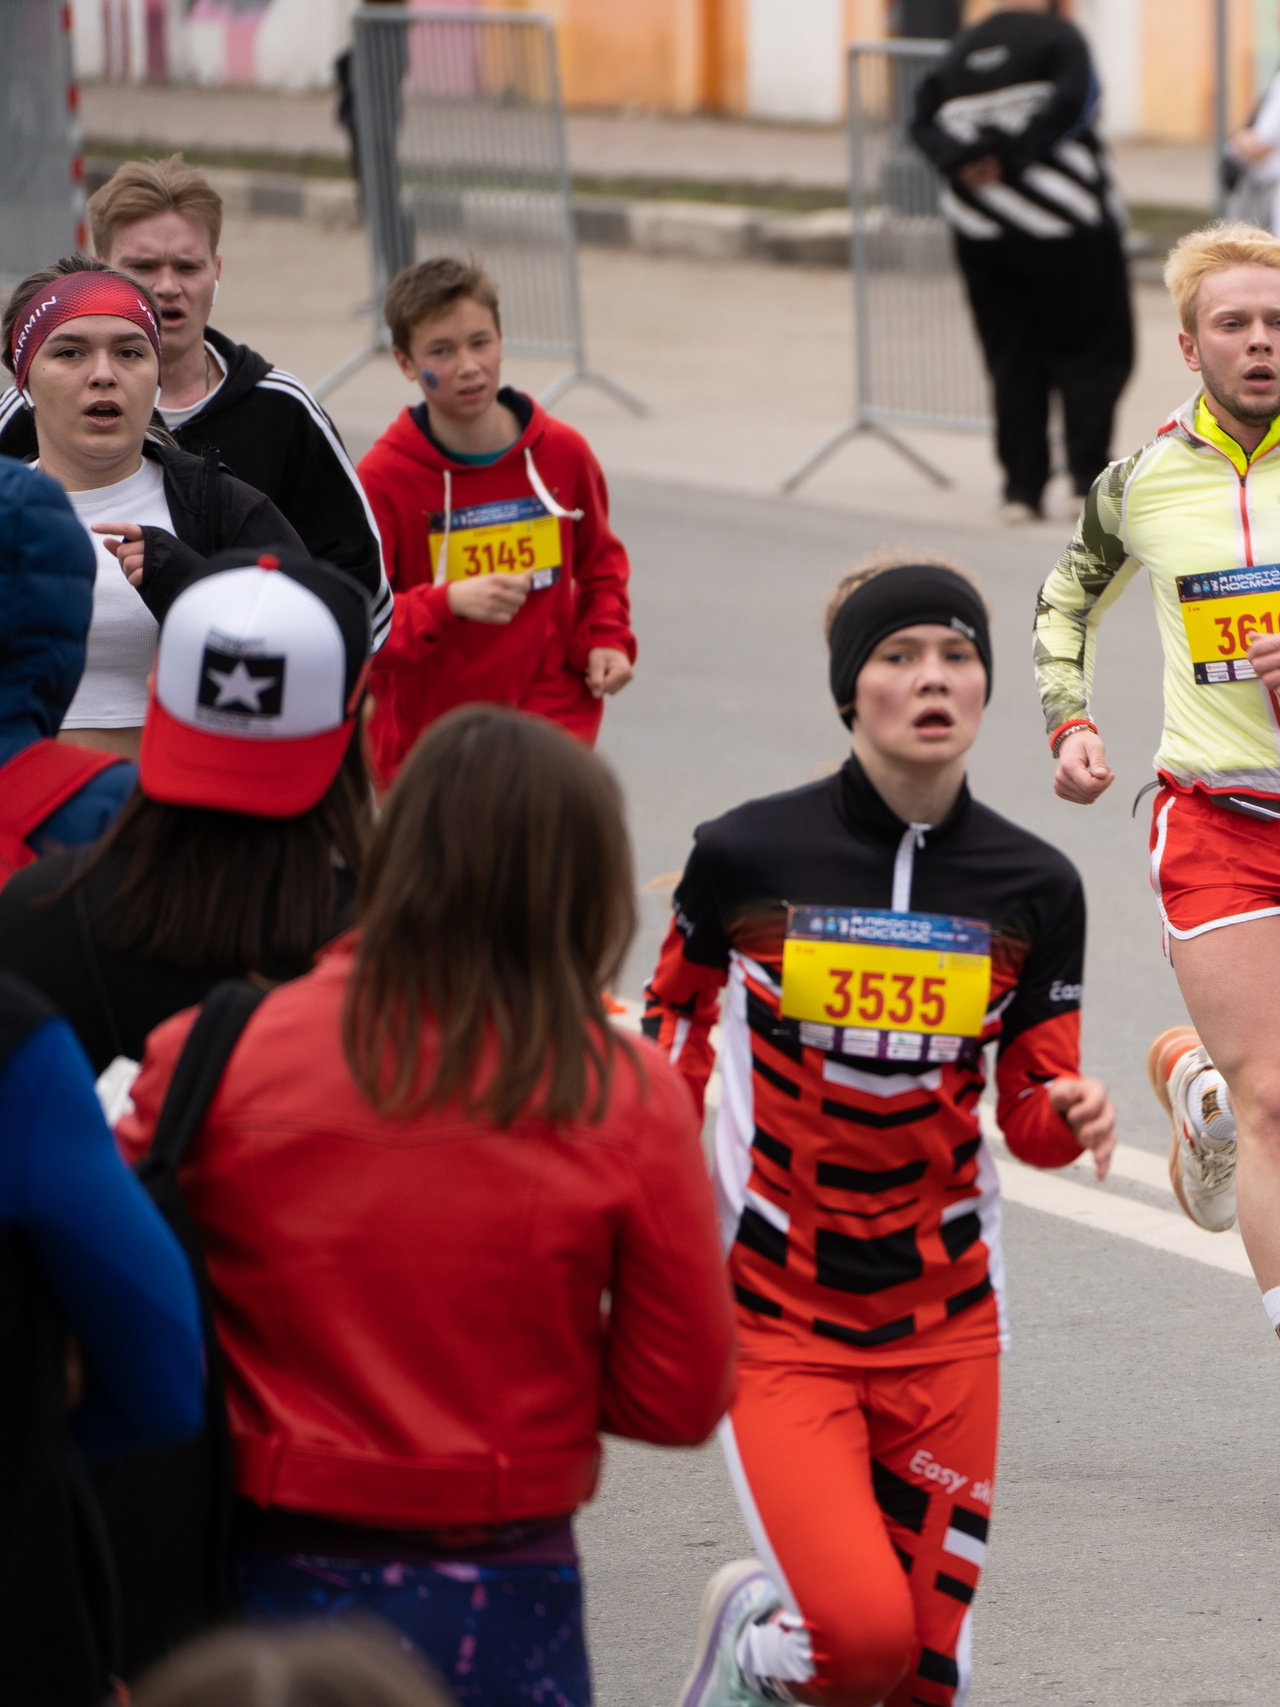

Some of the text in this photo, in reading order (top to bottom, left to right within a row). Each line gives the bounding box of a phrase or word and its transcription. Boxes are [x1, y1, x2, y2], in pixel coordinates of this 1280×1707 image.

[462, 537, 536, 577] 3145
[1228, 570, 1280, 582] ПРОСТО
[825, 969, 947, 1027] 3535
[908, 1449, 970, 1495] Easy
